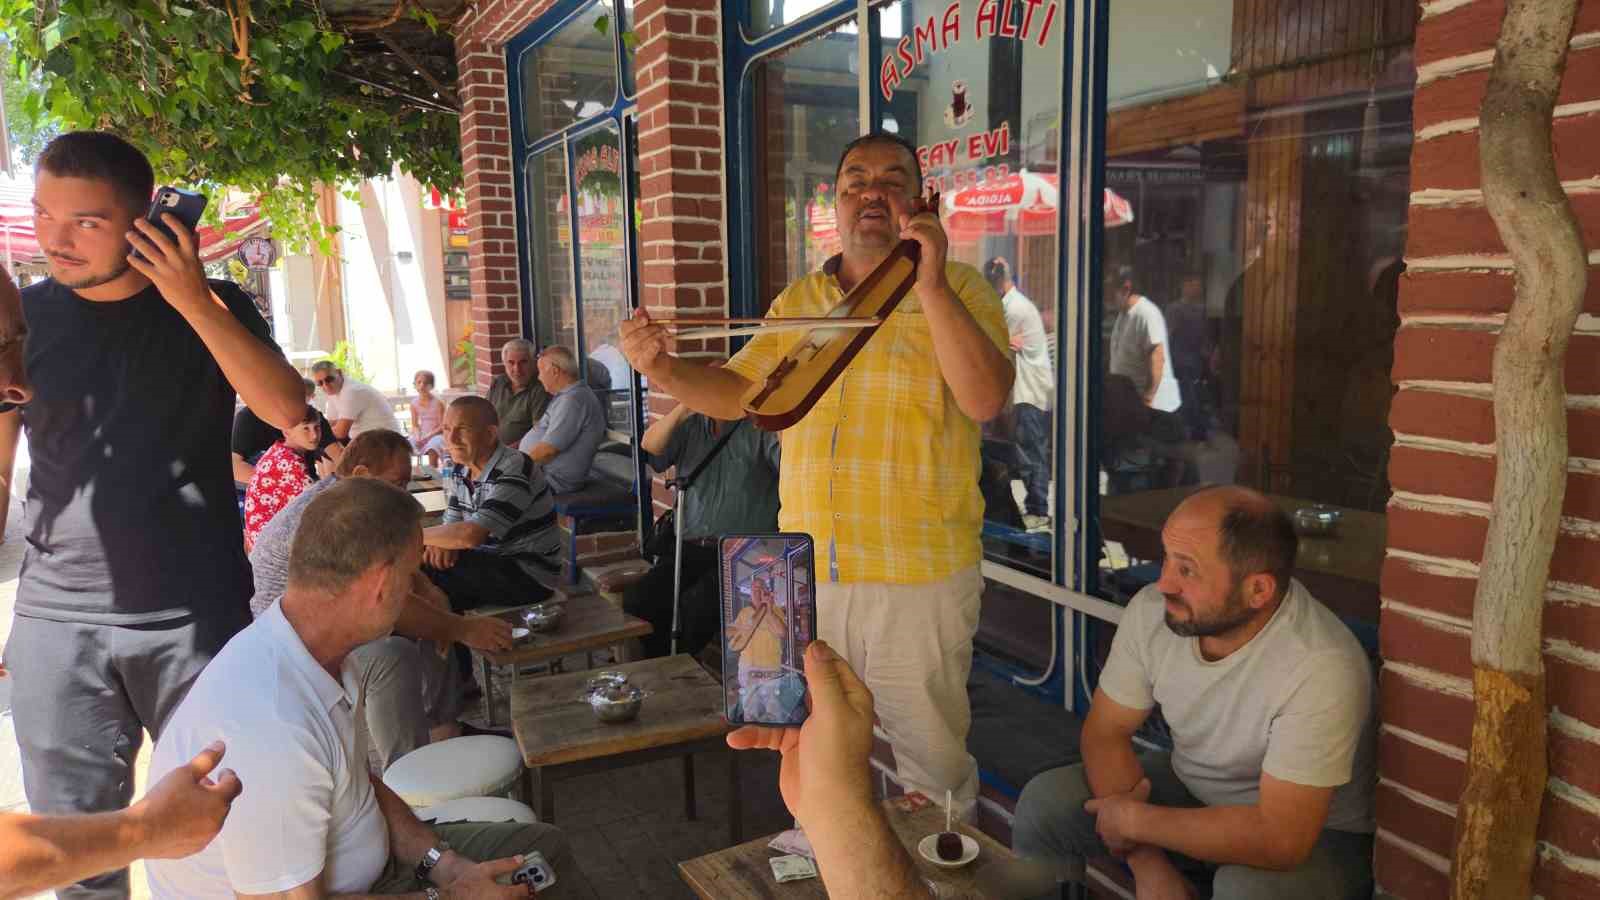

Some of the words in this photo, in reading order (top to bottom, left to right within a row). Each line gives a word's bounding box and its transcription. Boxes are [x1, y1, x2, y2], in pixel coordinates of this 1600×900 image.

[881, 2, 960, 101] ASMA
[976, 0, 1056, 47] ALTI
[967, 121, 1009, 158] EVİ
